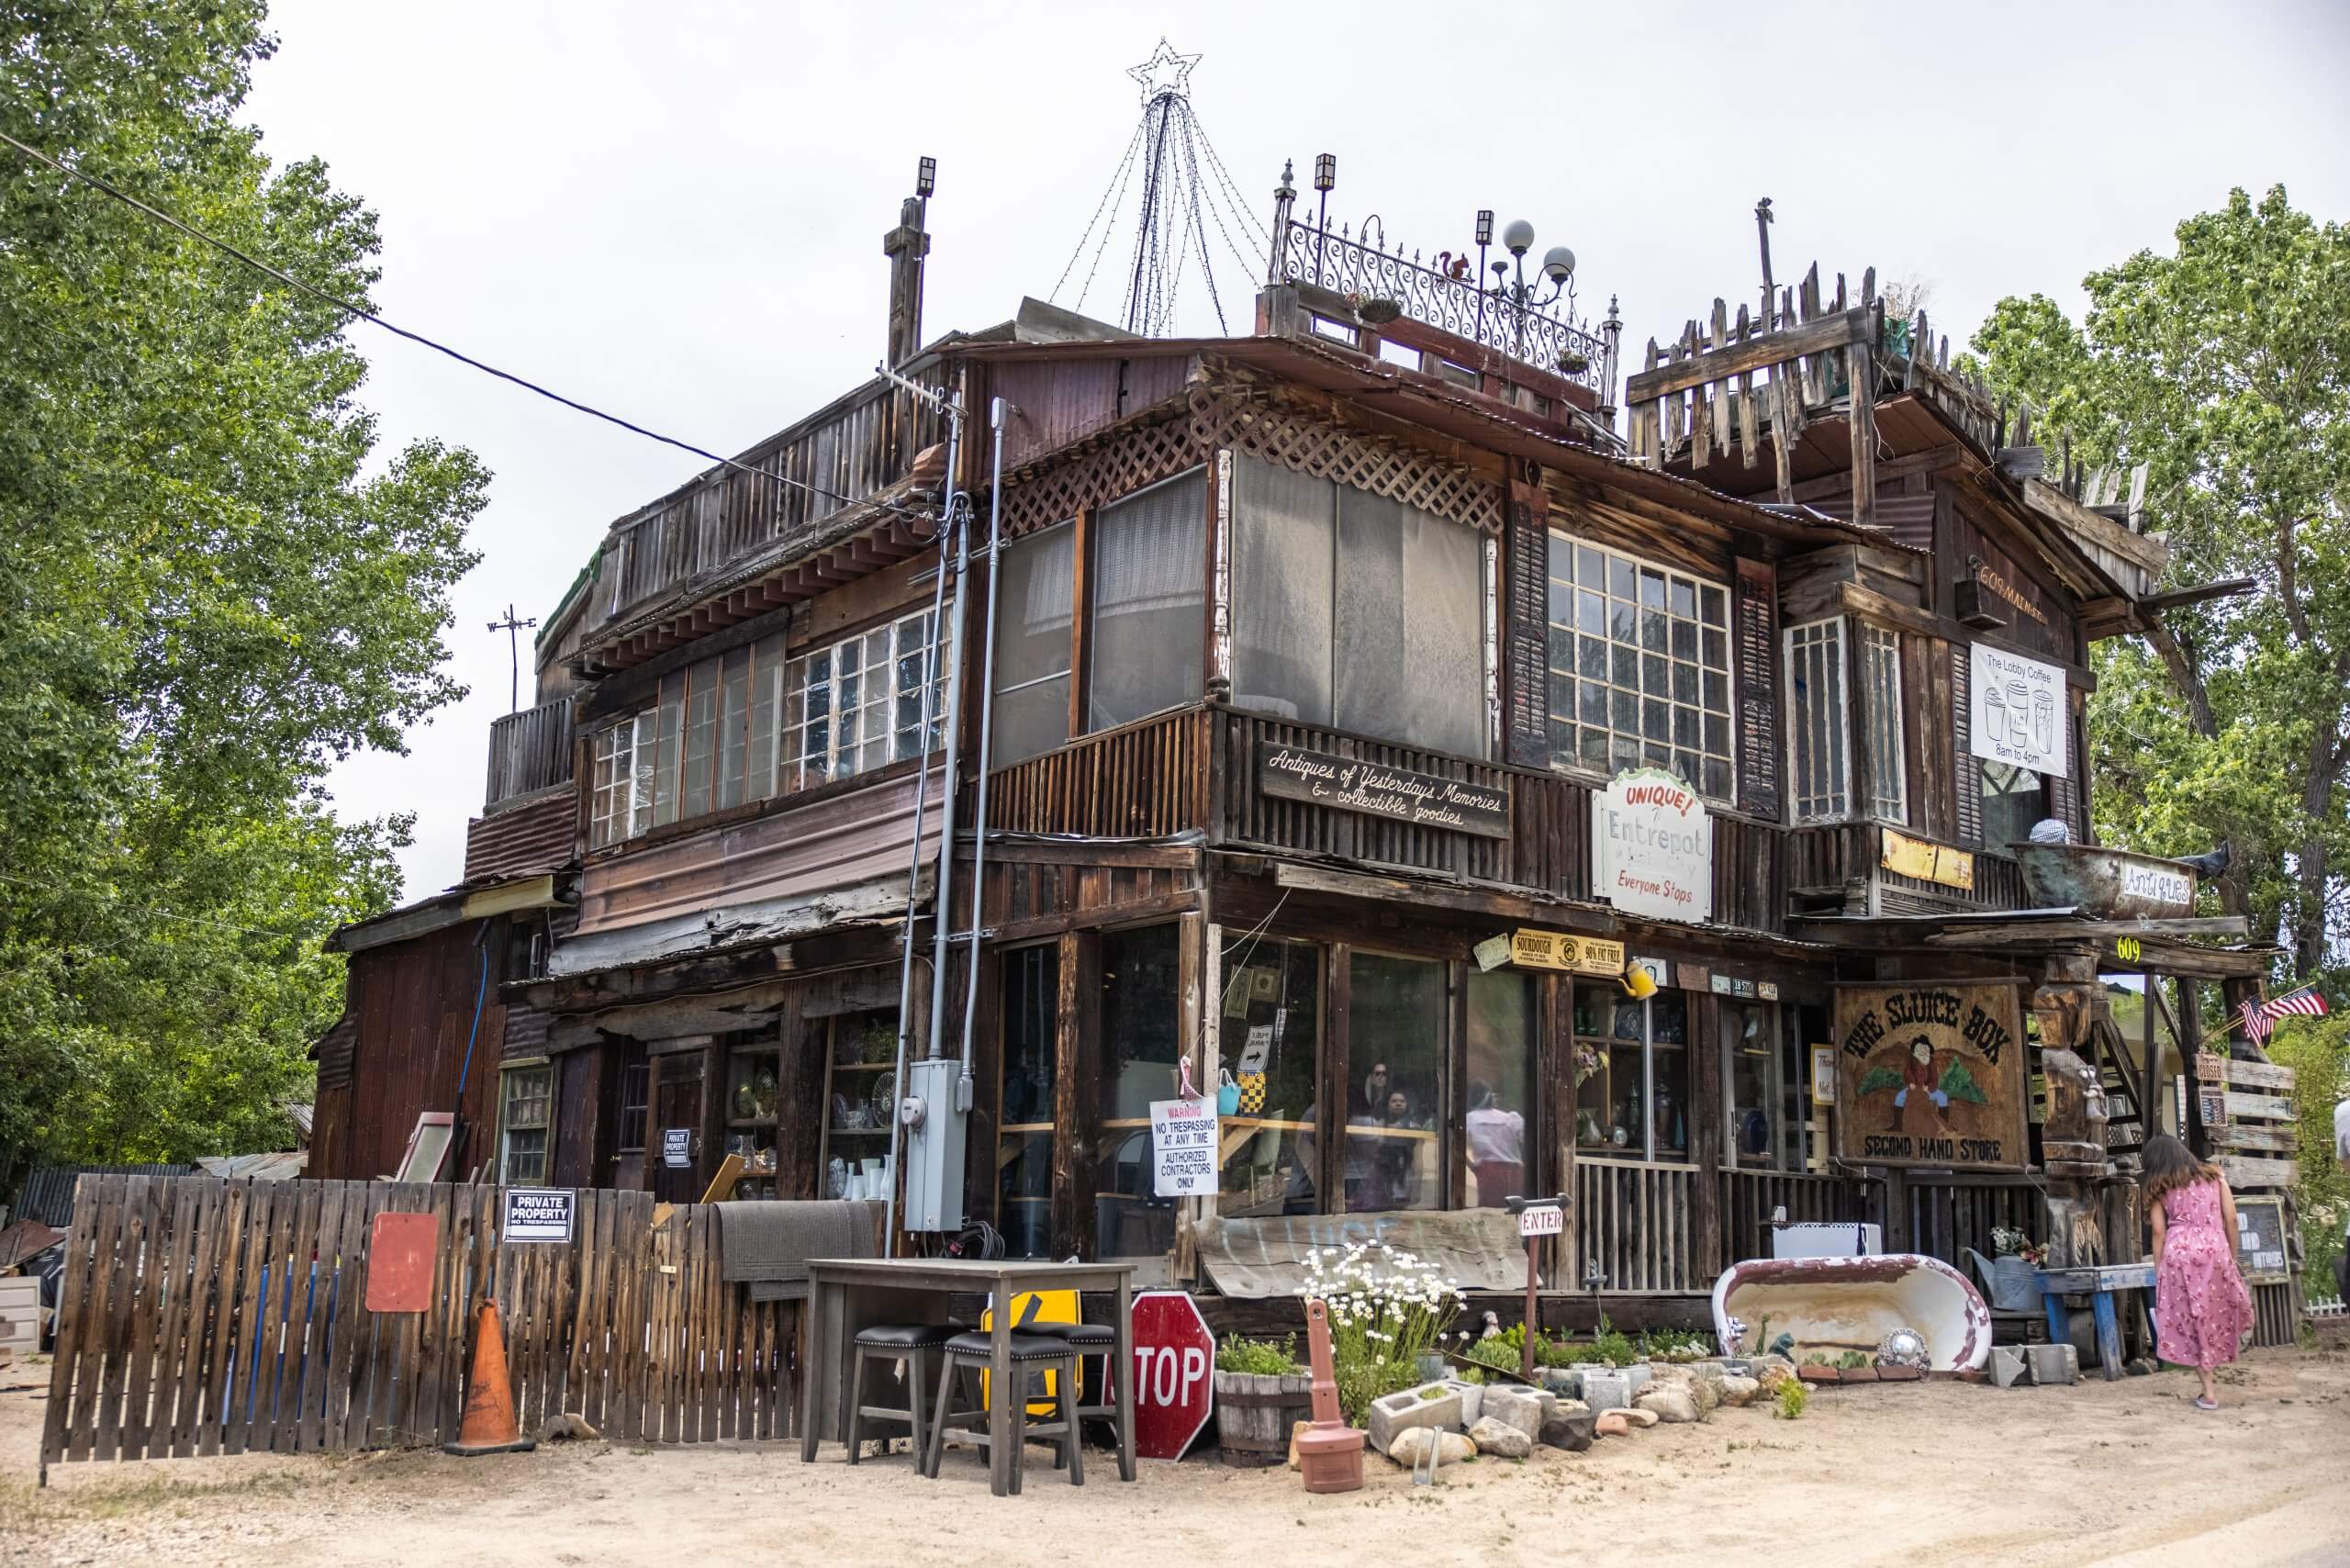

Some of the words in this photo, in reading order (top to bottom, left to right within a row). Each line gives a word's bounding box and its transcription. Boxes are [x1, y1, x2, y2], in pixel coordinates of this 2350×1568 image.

[1986, 654, 2002, 669] The
[2004, 659, 2026, 678] Lobby
[2028, 666, 2052, 683] Coffee
[1996, 743, 2012, 756] 8am
[2014, 748, 2021, 760] to
[2023, 751, 2040, 765] 4pm
[1269, 750, 1335, 779] Antiques
[1340, 766, 1357, 787] of
[1437, 783, 1501, 812] Memories
[1313, 781, 1328, 796] &
[1337, 788, 1407, 814] collectible
[1627, 786, 1694, 817] UNIQUE!
[1608, 810, 1704, 857] Entrepot
[1618, 869, 1660, 897] Everyone
[1663, 880, 1693, 906] Stops
[2125, 868, 2190, 902] Antiques
[1516, 937, 1551, 954] SOURDOUGH
[1585, 946, 1596, 960] 98%
[1597, 947, 1606, 962] FAT
[1607, 948, 1621, 963] FREE
[2117, 935, 2141, 963] 609
[1844, 1010, 1886, 1059] THE
[1886, 991, 1961, 1030] SLUICE
[1963, 1005, 2011, 1066] BOX
[2199, 1064, 2221, 1078] CLOSED
[1168, 1105, 1202, 1118] WARNING
[1156, 1123, 1167, 1135] NO
[1170, 1119, 1215, 1132] TRESPASSING
[1164, 1135, 1172, 1147] AT
[1176, 1134, 1190, 1145] ANY
[1193, 1132, 1208, 1144] TIME
[1864, 1136, 1912, 1158] SECOND
[1919, 1137, 1953, 1159] HAND
[1960, 1138, 2001, 1161] STORE
[1166, 1150, 1207, 1164] AUTHORIZED
[1161, 1162, 1211, 1176] CONTRACTORS
[1177, 1177, 1194, 1189] ONLY
[518, 1196, 564, 1208] PRIVATE
[511, 1208, 568, 1219] PROPERTY
[1524, 1211, 1562, 1229] ENTER
[1110, 1346, 1205, 1407] TOP
